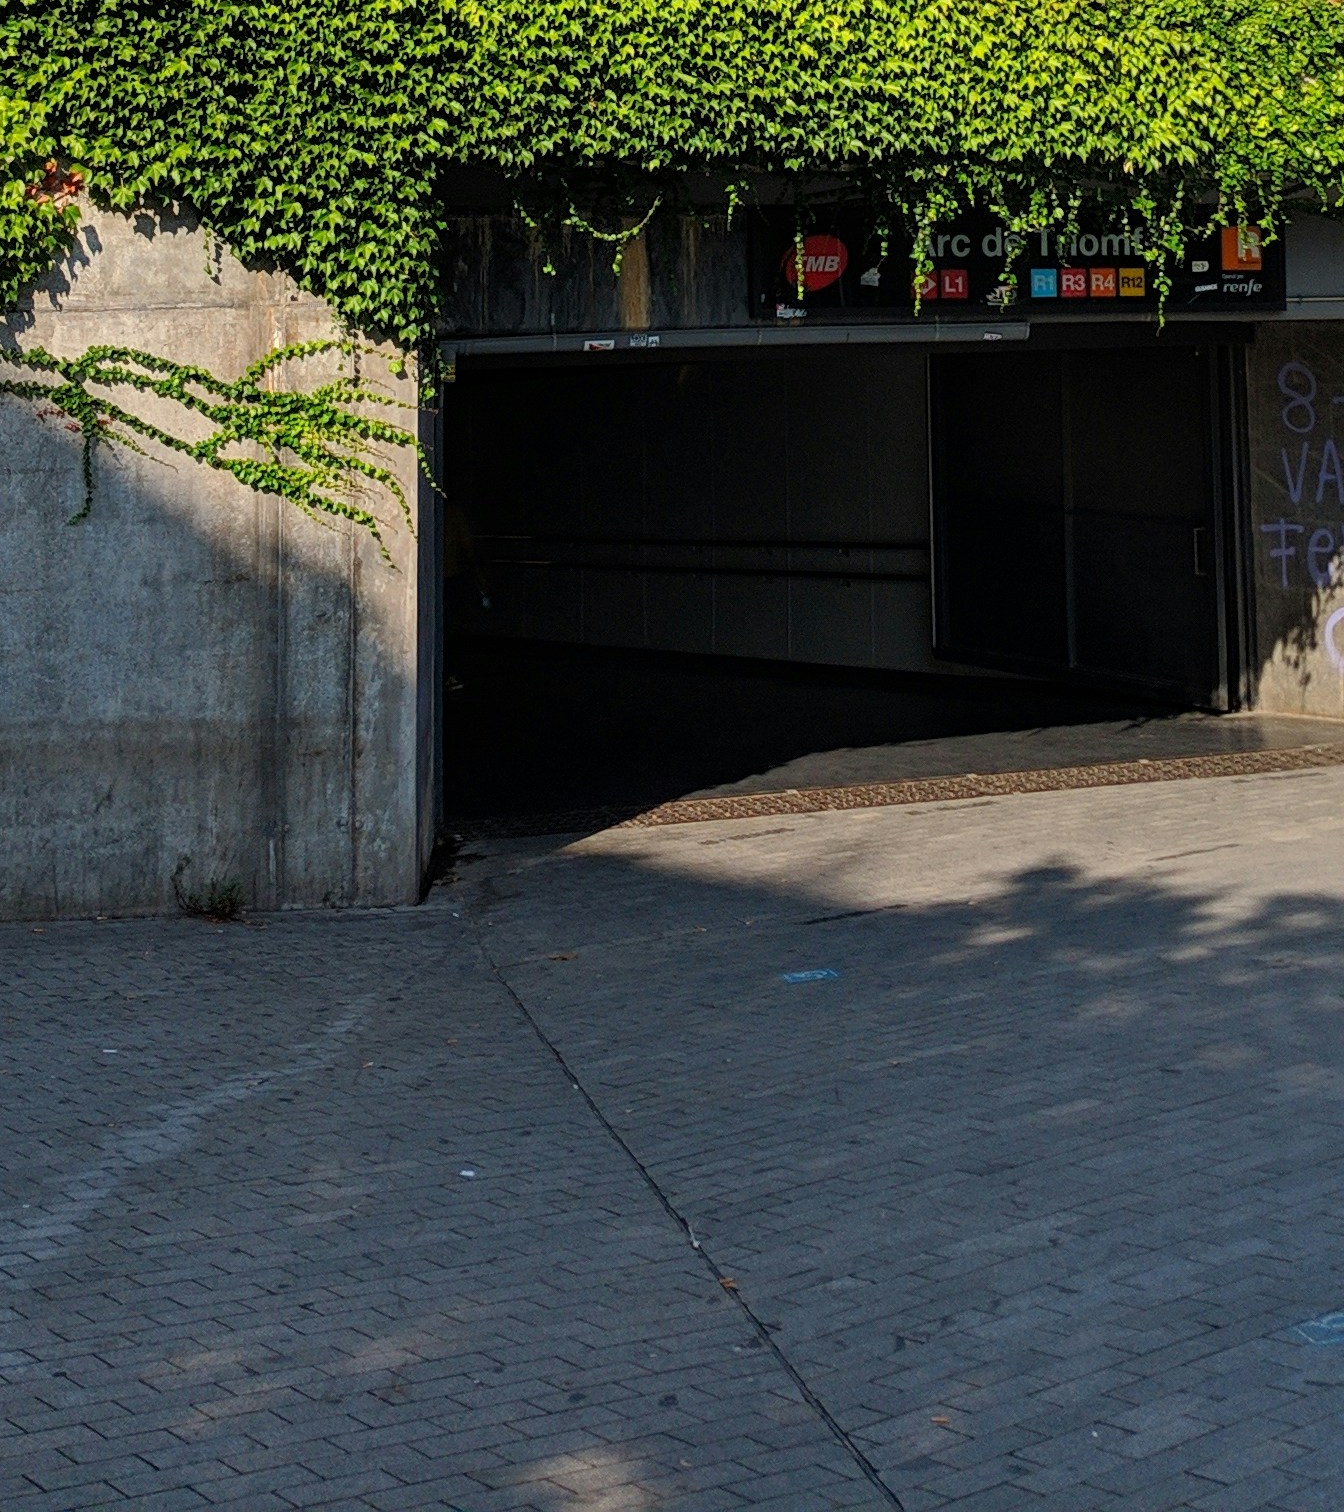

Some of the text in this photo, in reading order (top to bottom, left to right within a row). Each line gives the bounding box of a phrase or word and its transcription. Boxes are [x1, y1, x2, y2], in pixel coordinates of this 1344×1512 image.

[981, 226, 1023, 258] de
[796, 255, 840, 272] MB
[944, 274, 1143, 293] L1 R1 R3 R4 R12
[1222, 278, 1263, 297] renfe
